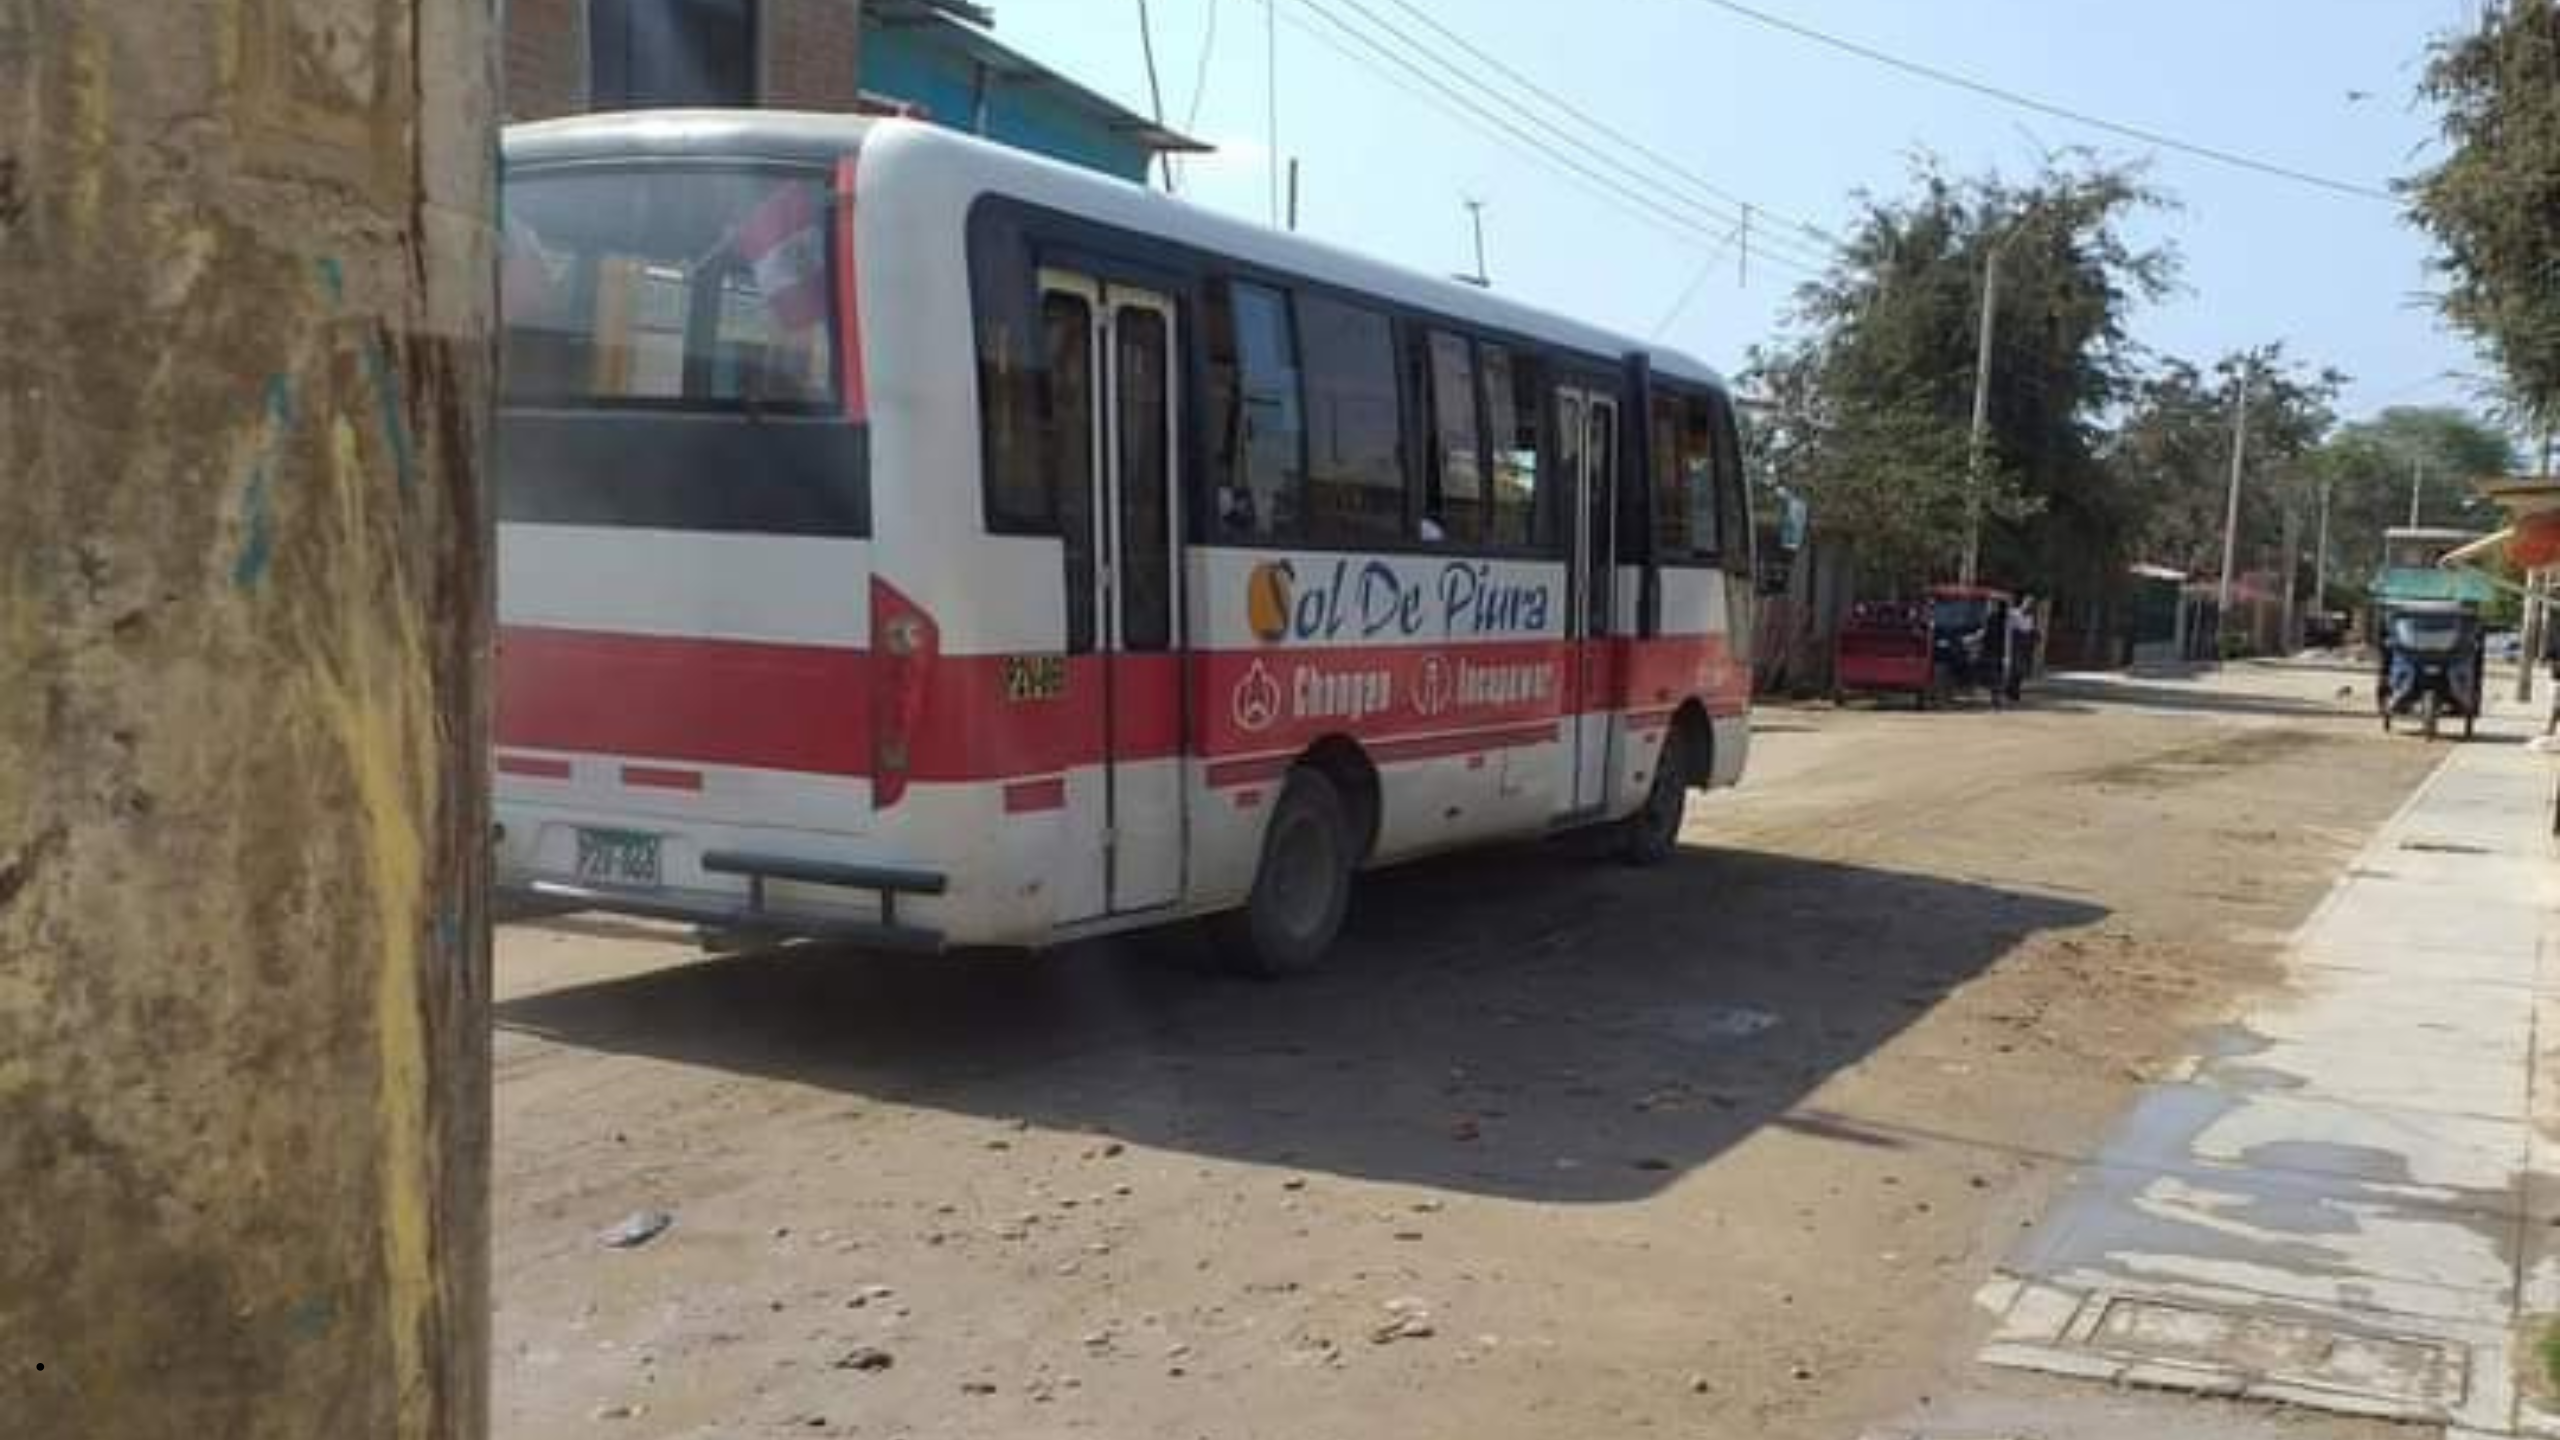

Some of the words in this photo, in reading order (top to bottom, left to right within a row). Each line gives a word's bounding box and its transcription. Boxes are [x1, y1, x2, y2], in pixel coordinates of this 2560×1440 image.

[1249, 558, 1346, 640] Sol
[1358, 560, 1422, 635] De
[1440, 560, 1549, 632] Piura
